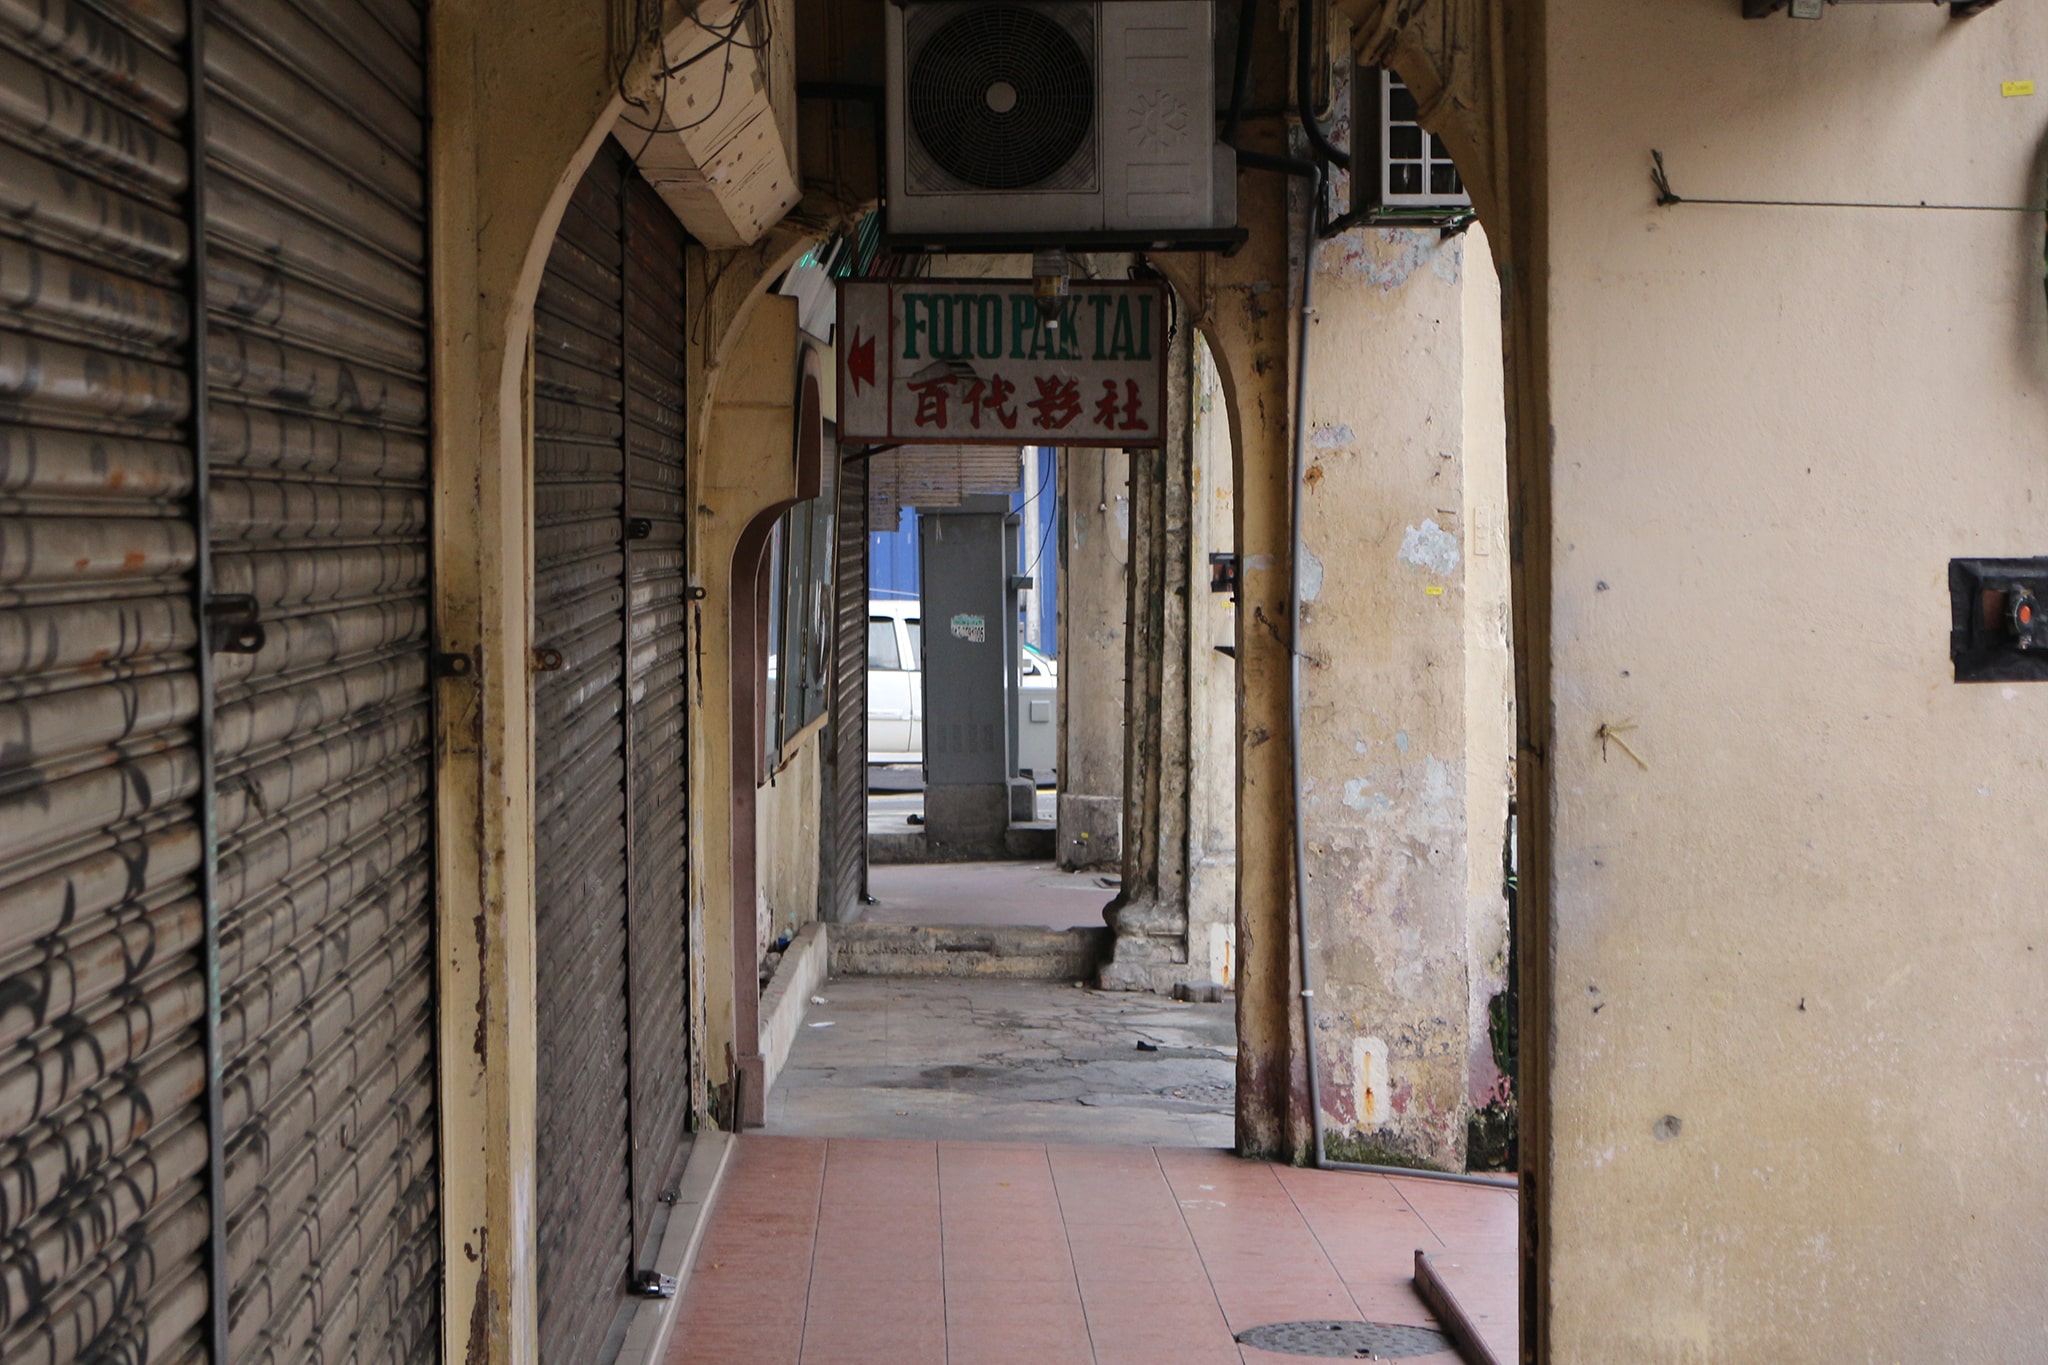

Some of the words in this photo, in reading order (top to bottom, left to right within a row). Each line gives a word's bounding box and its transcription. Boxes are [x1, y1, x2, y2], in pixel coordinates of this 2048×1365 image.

[903, 294, 1003, 359] FOTO
[1009, 294, 1083, 360] PAK
[1088, 294, 1153, 360] TAI
[907, 373, 1149, 431] 百代影社
